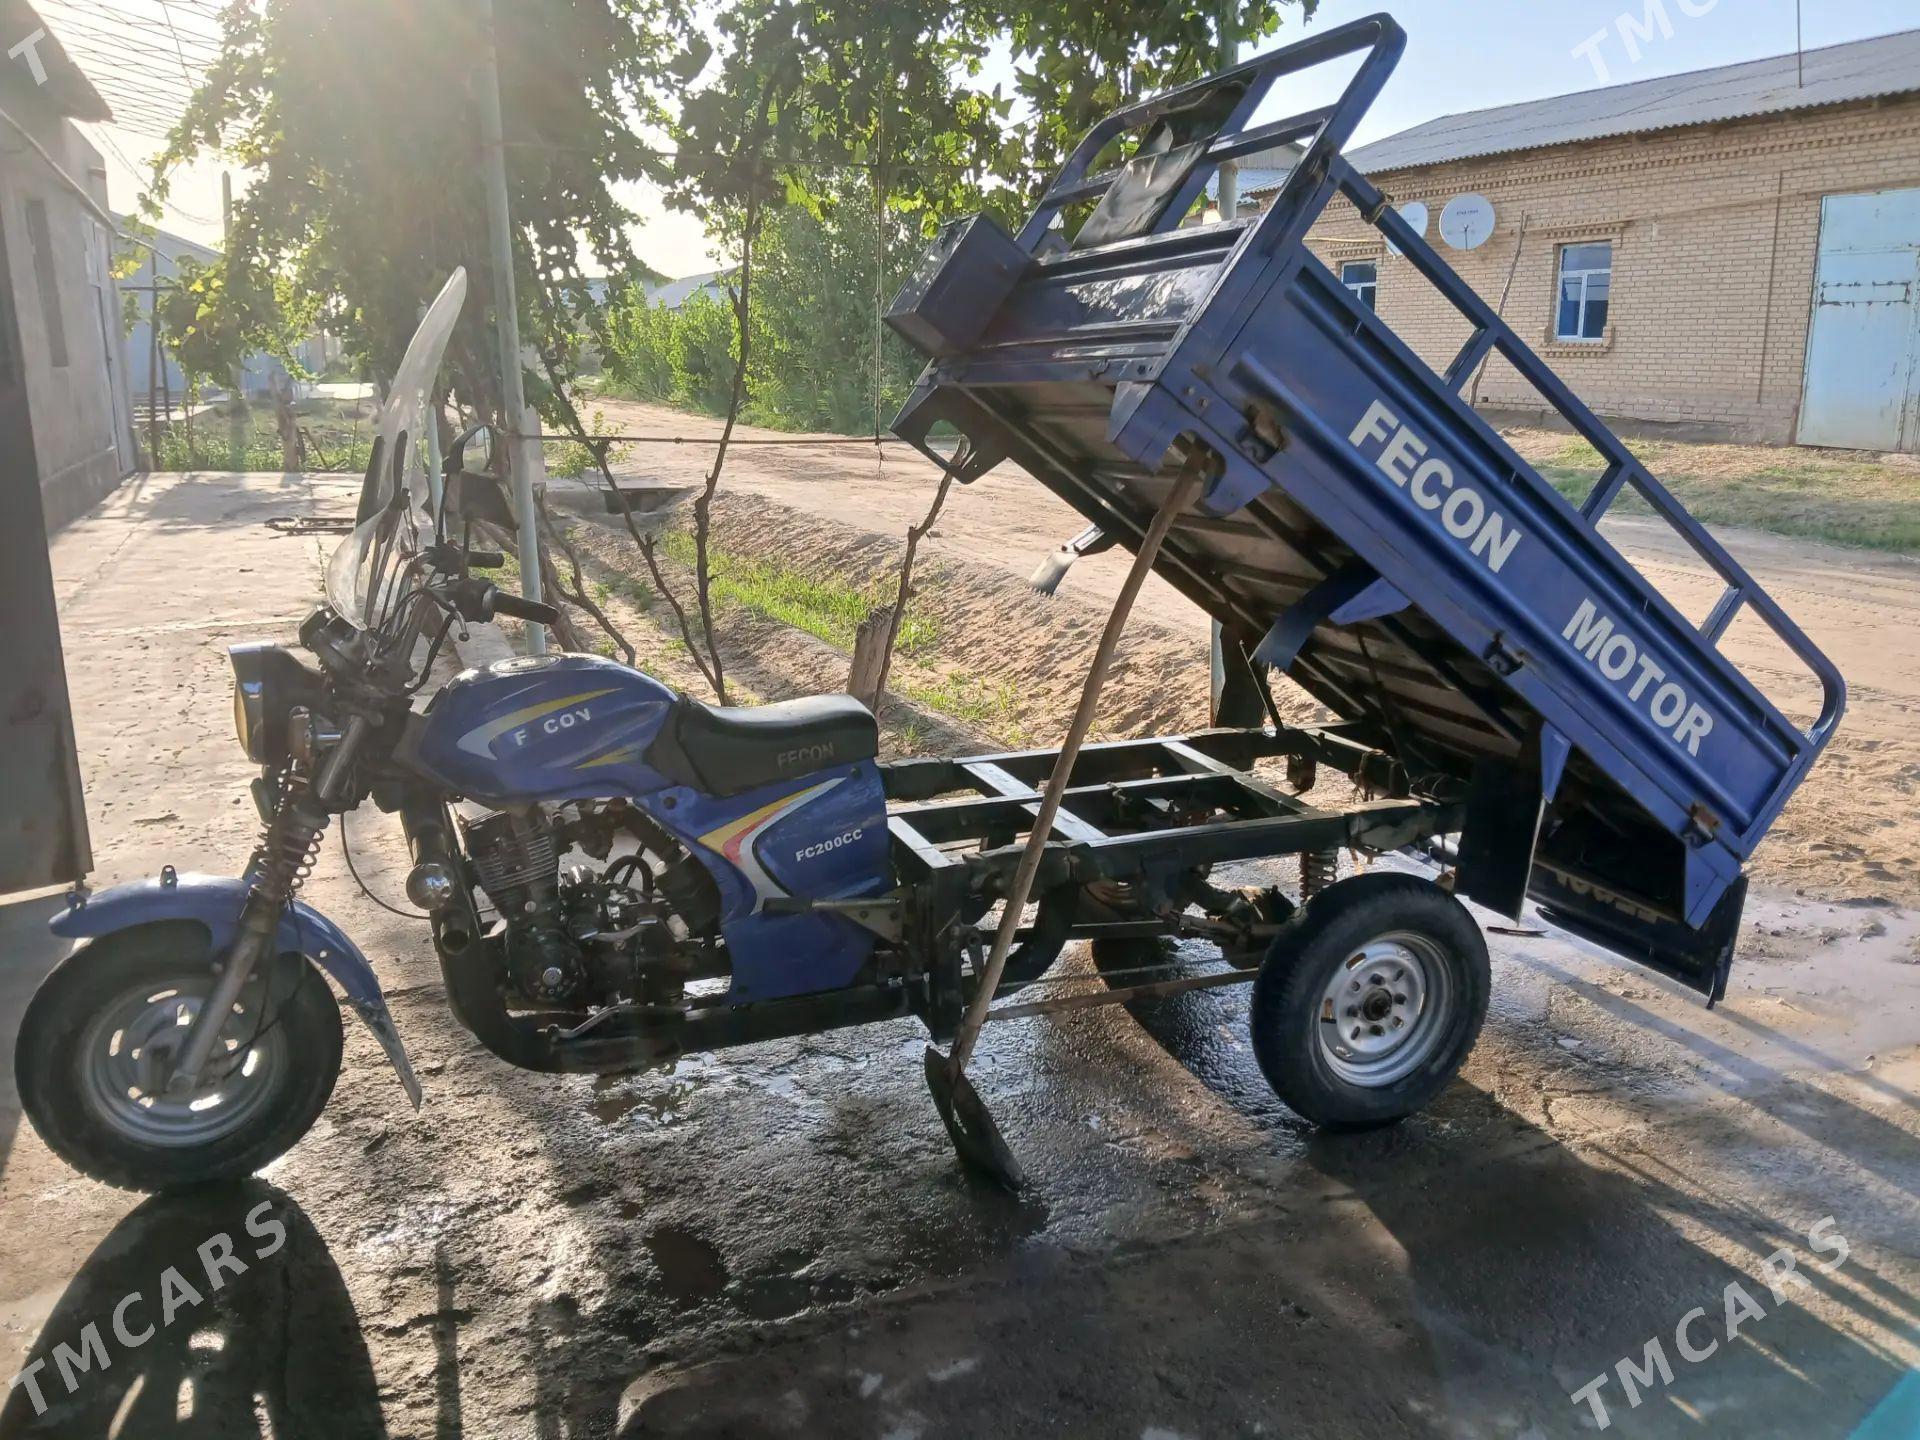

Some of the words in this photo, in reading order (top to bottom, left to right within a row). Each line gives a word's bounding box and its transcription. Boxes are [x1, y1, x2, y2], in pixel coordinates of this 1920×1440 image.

[1348, 399, 1522, 574] FECON
[1561, 598, 1713, 757] MOTOR
[795, 828, 863, 862] FC200CC
